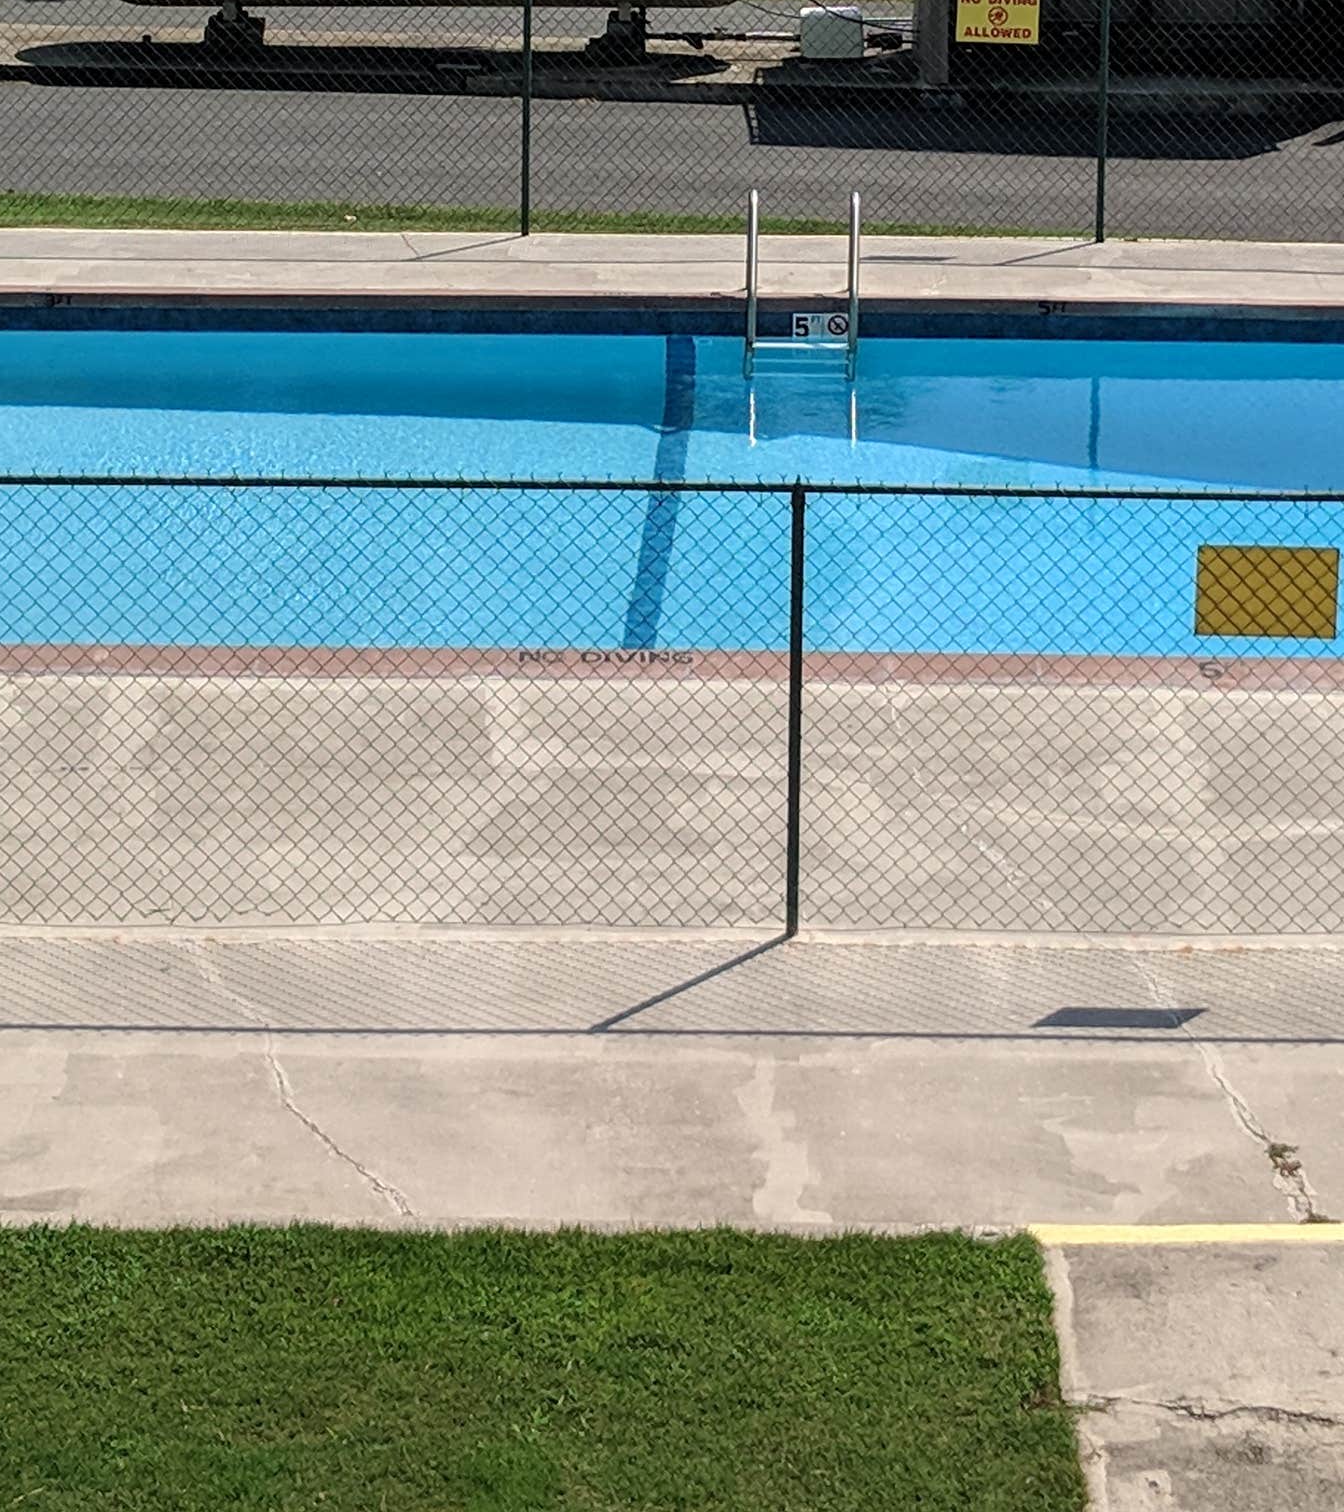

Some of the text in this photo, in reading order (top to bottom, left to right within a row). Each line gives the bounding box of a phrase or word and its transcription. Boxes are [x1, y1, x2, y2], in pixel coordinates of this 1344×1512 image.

[964, 26, 1031, 39] ALLOWED
[794, 317, 810, 337] 5
[519, 651, 693, 665] NO DIVING
